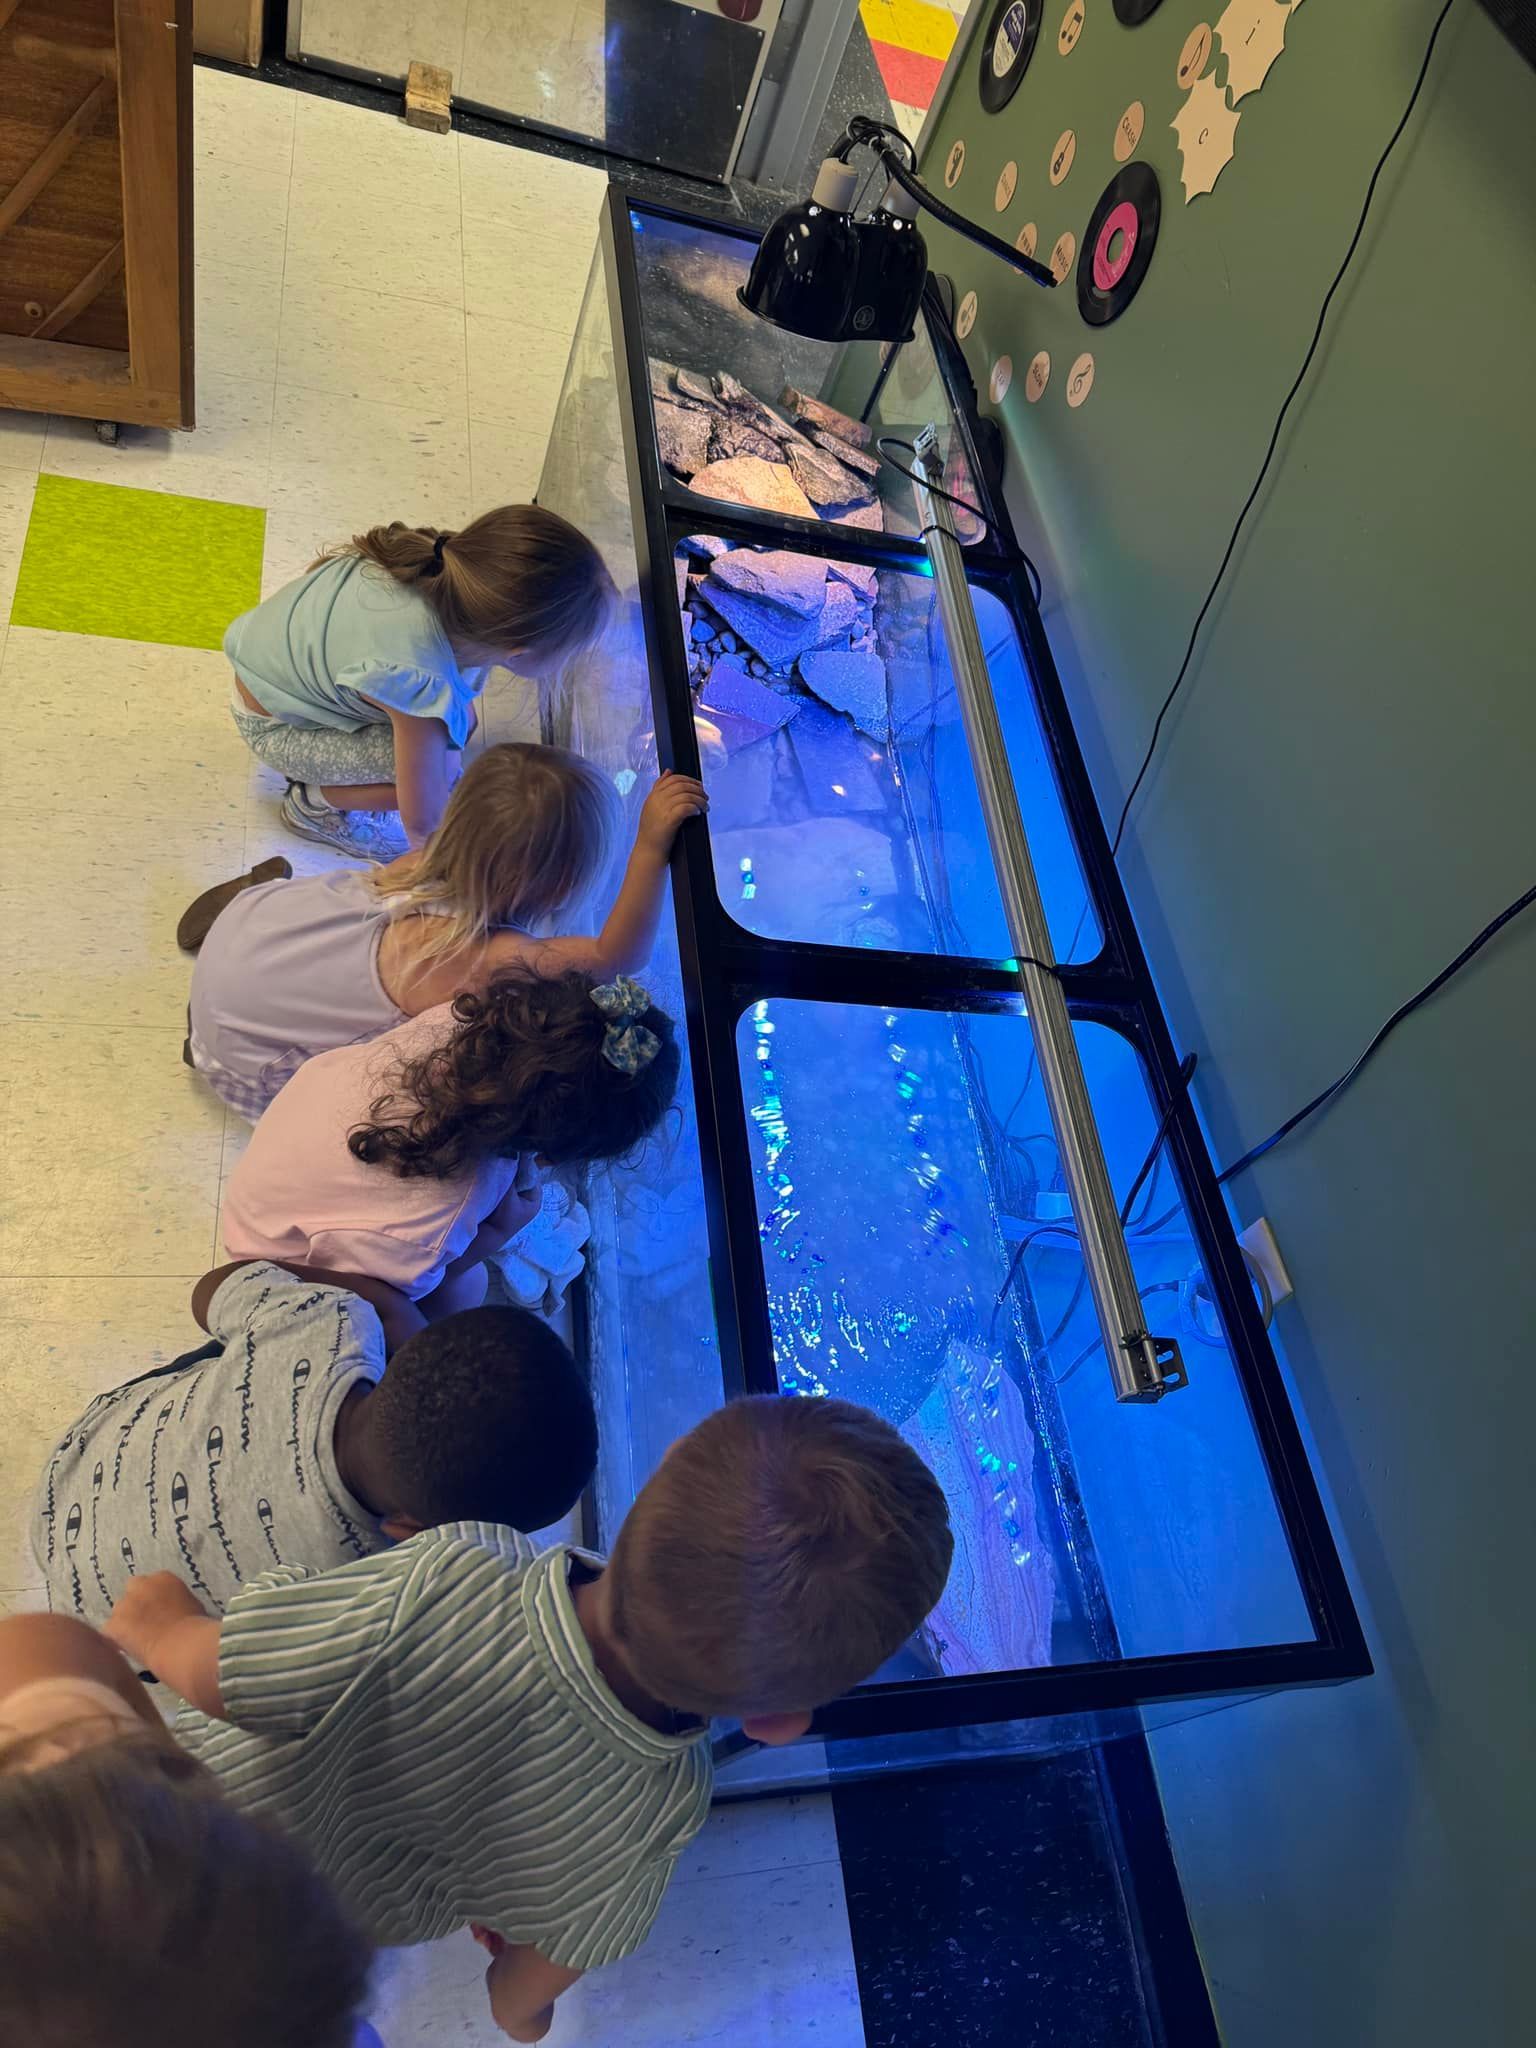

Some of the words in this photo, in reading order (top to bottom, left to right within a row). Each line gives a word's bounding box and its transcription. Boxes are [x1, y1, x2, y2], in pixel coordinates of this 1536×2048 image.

[1056, 244, 1070, 272] MUSIC
[145, 1400, 175, 1539] Champion
[287, 1358, 311, 1495] Champion
[90, 1462, 114, 1609] Champion
[206, 1426, 243, 1582] Champion
[257, 1498, 282, 1566] Cham
